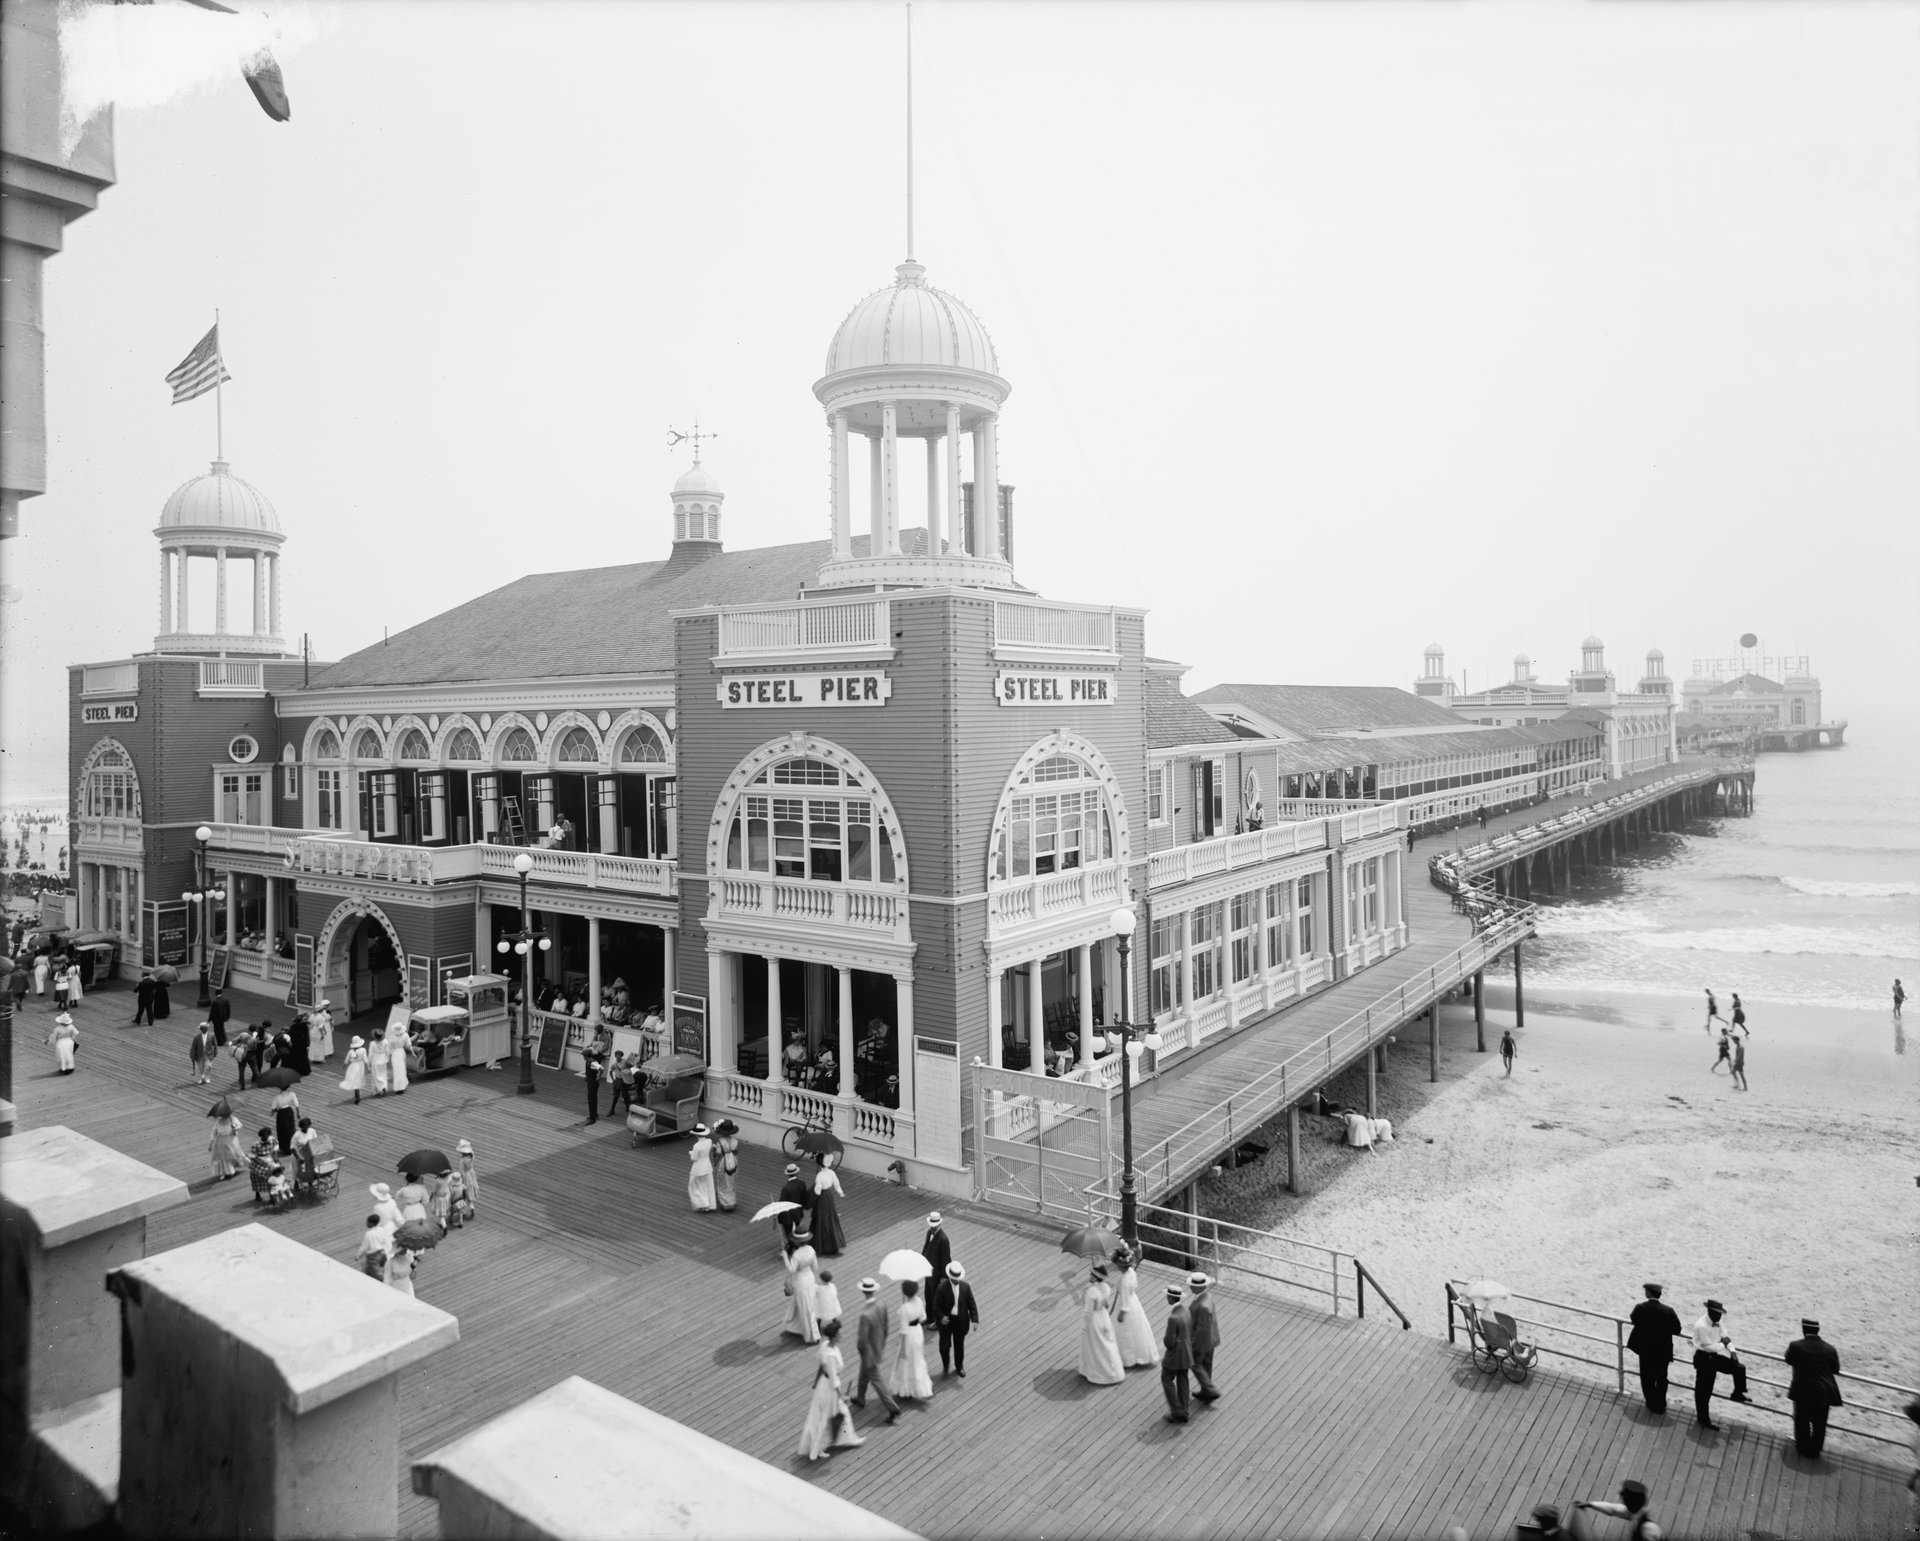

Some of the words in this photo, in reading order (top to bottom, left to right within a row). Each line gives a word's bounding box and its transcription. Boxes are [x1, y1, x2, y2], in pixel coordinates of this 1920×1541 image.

[1692, 658, 1752, 673] STEEL
[1763, 655, 1810, 672] PIER
[727, 679, 803, 704] STEEL
[820, 676, 880, 702] PIER
[1004, 677, 1064, 701] STEEL
[1070, 678, 1109, 701] PIER
[85, 706, 111, 721] STEEL
[114, 704, 135, 719] PIER
[283, 838, 356, 877] STEEL
[367, 846, 435, 886] PIER
